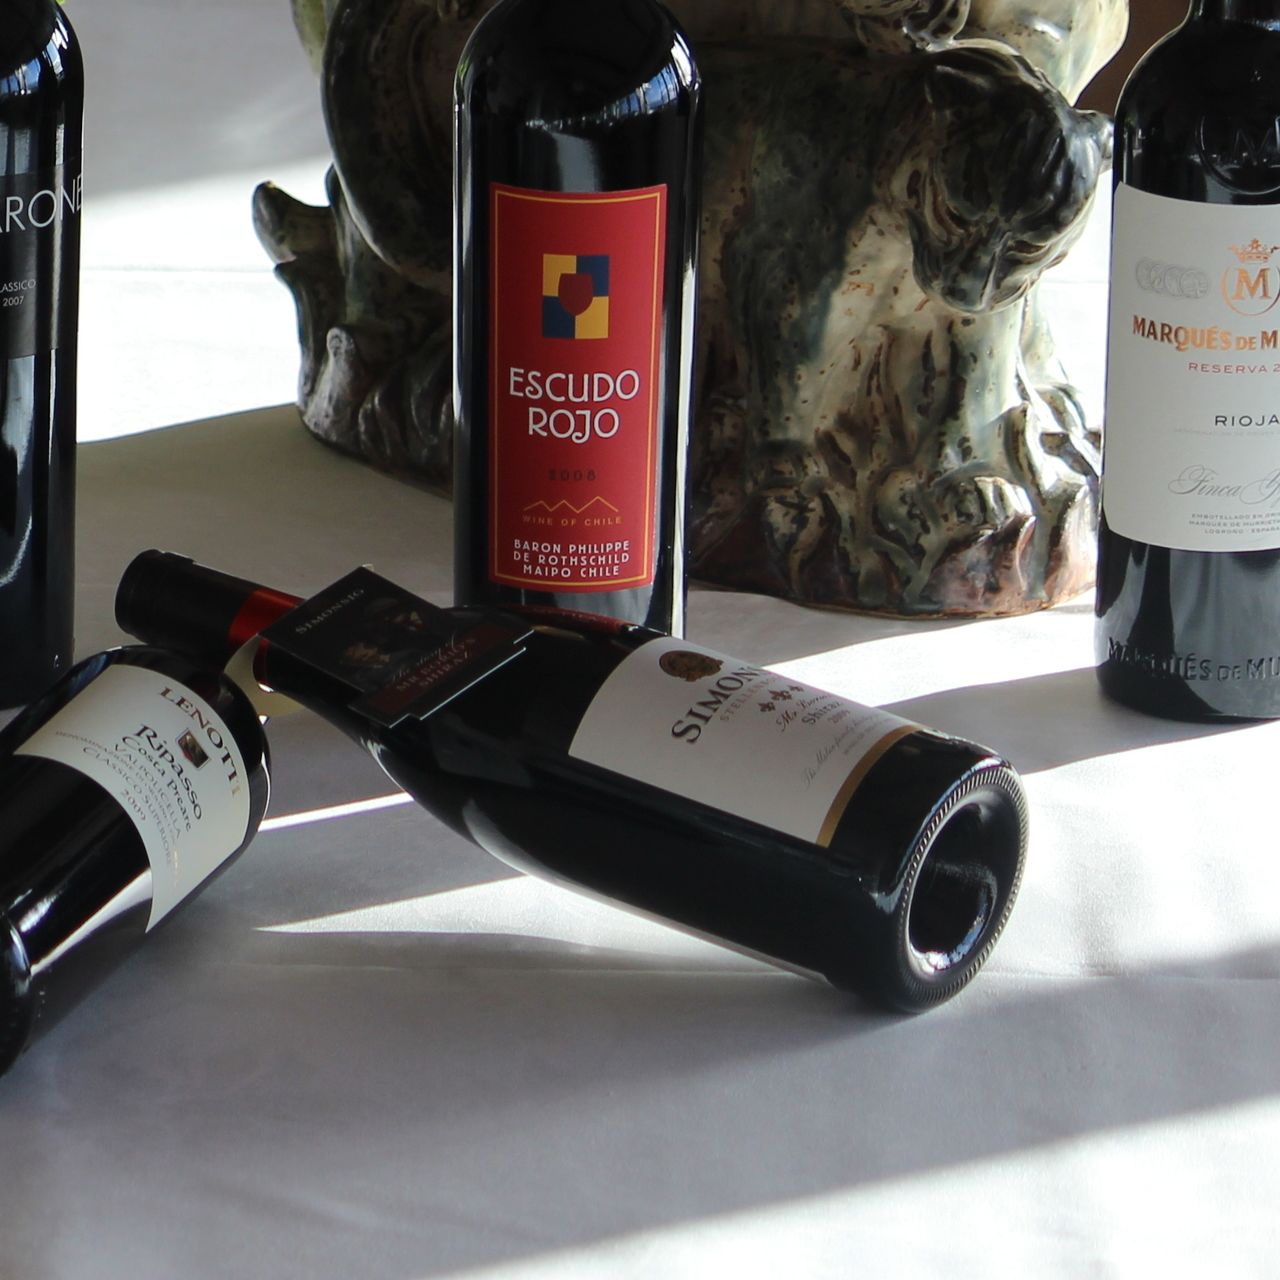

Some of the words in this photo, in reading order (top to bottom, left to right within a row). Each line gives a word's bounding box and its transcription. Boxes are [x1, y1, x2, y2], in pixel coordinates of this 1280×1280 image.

[1232, 267, 1271, 300] M
[2, 295, 25, 307] 2007
[1132, 314, 1233, 352] MARQUÉS
[1235, 335, 1257, 351] DE
[508, 367, 641, 403] ESCUDO
[1188, 362, 1268, 374] RESERVA
[527, 406, 621, 444] ROJO
[1214, 413, 1280, 427] RIOJA
[521, 513, 554, 527] WINE
[560, 518, 577, 527] OF
[583, 515, 623, 527] CHILE
[513, 538, 561, 554] BARON
[568, 539, 631, 555] PHILIPPE
[513, 550, 531, 563] DE
[537, 552, 631, 567] ROTHSCHILD
[522, 563, 572, 579] MAIPO
[579, 564, 621, 578] CHILE
[295, 587, 365, 635] SIMONSIG
[82, 746, 143, 795] CLASSICO
[122, 735, 166, 777] Costa
[166, 779, 193, 834] Preare
[134, 723, 203, 820] Ripasso
[114, 743, 183, 841] VALPOLICELLA
[120, 788, 148, 822] 2009
